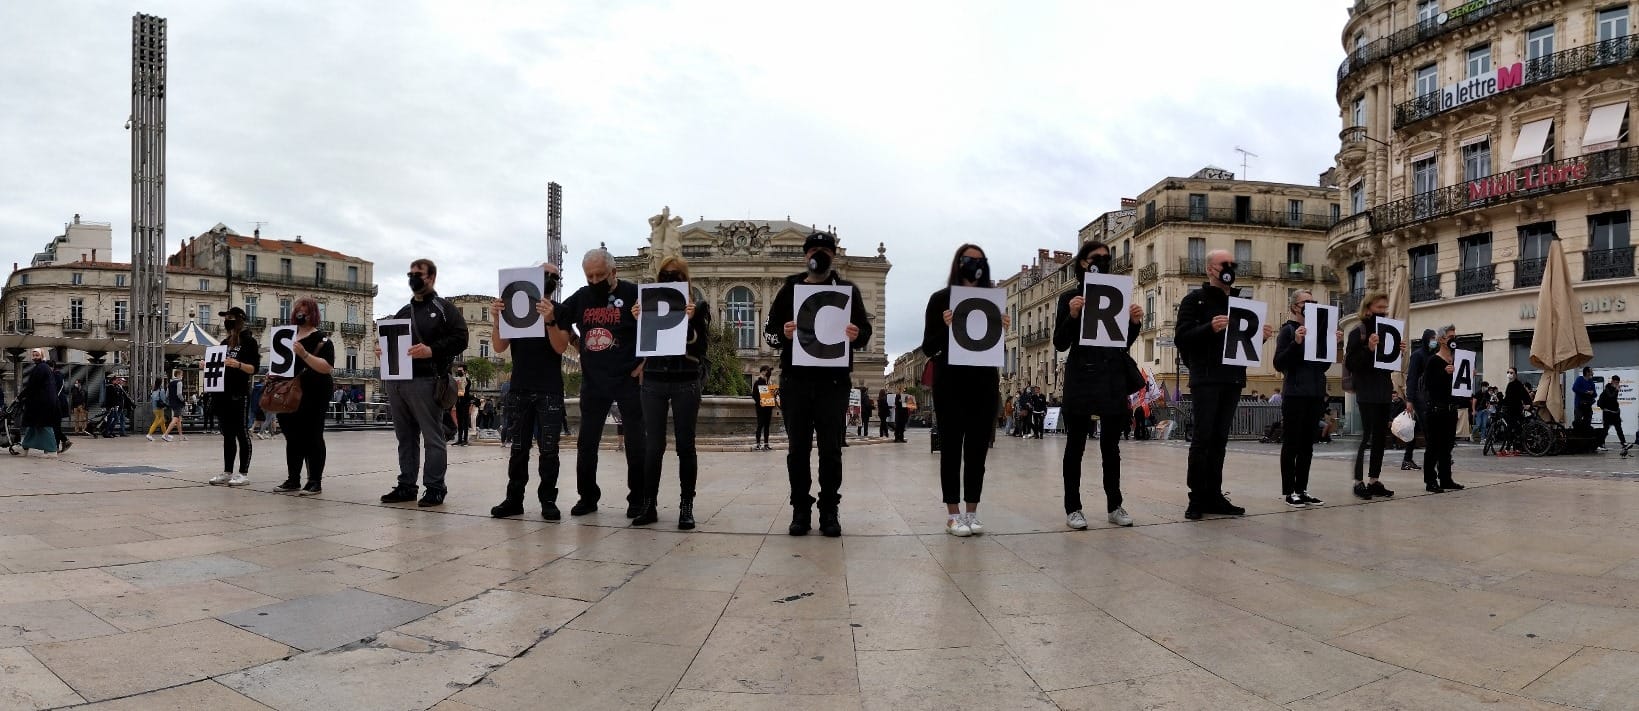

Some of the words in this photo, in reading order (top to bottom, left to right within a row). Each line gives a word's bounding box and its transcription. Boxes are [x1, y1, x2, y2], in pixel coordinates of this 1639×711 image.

[1441, 87, 1453, 109] la
[1468, 171, 1517, 201] Midi
[1524, 162, 1586, 190] Libre
[501, 280, 541, 329] O
[639, 286, 687, 351] P
[796, 290, 850, 359] C
[951, 297, 1002, 352] O
[1082, 283, 1125, 342] R
[270, 328, 294, 374] S
[378, 323, 410, 376] T
[1224, 306, 1260, 361] R
[1315, 307, 1329, 359] I
[1376, 323, 1402, 364] D
[204, 352, 225, 388] #
[1453, 359, 1472, 390] A
